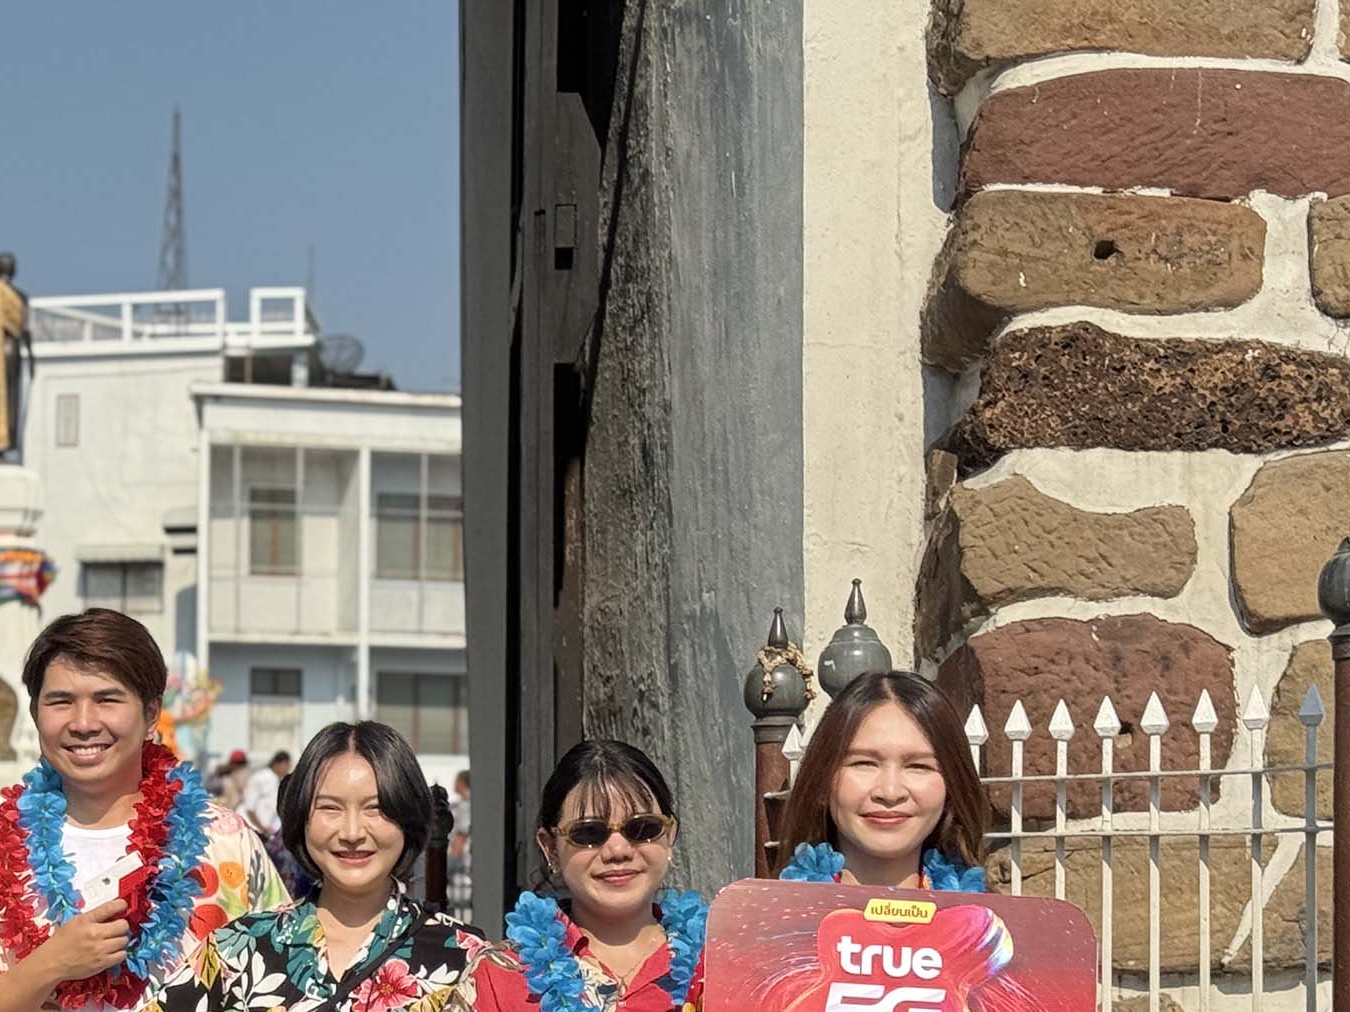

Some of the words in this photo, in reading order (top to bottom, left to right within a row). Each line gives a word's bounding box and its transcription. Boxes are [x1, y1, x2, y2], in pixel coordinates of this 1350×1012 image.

[871, 902, 928, 918] เปลี่ยนเป็น
[836, 935, 943, 979] true
